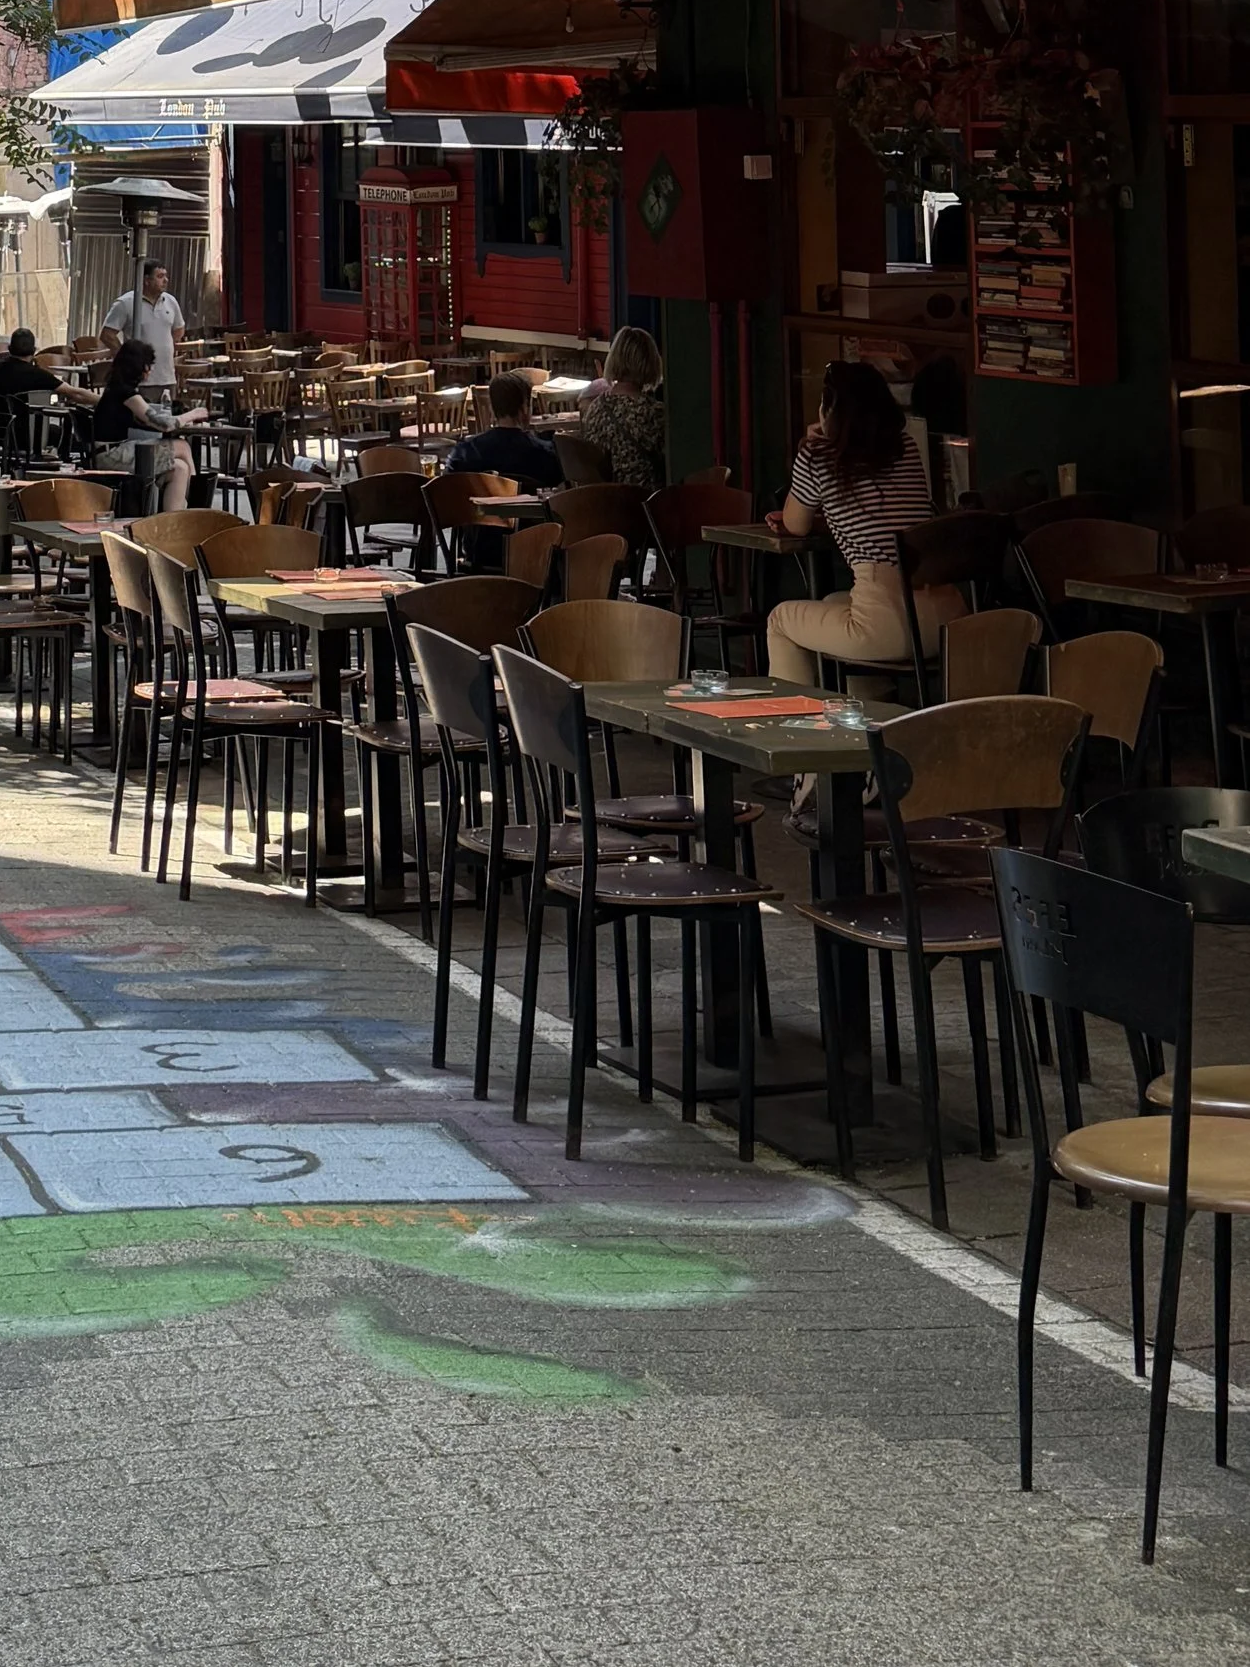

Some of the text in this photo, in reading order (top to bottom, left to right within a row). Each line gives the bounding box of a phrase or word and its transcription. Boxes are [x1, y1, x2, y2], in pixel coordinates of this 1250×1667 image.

[158, 98, 226, 120] London Pub
[362, 187, 407, 202] TELEPHONE
[413, 190, 440, 200] London
[140, 1041, 239, 1072] 3
[217, 1143, 322, 1184] 6
